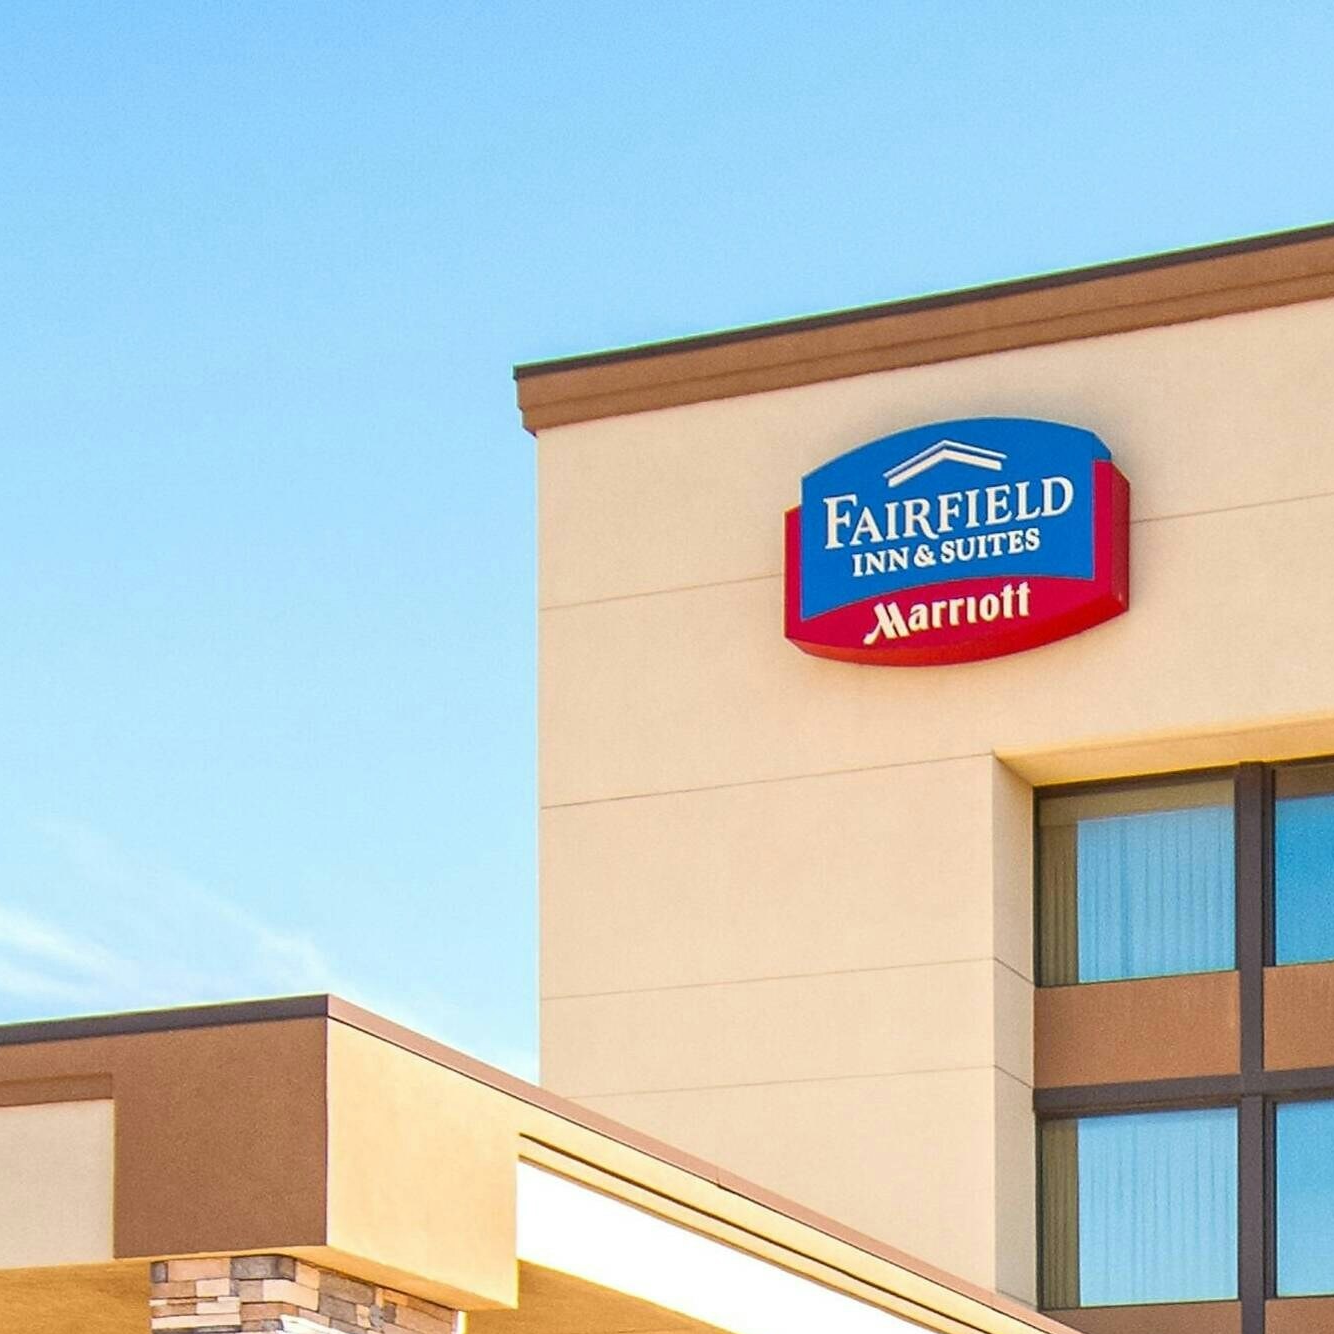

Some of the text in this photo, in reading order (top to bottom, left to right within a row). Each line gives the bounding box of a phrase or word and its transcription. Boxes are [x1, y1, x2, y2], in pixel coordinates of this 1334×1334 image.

[823, 476, 1074, 549] FAIRFIELD
[852, 527, 1041, 577] INN & SUITES
[863, 581, 1031, 645] Marriott
